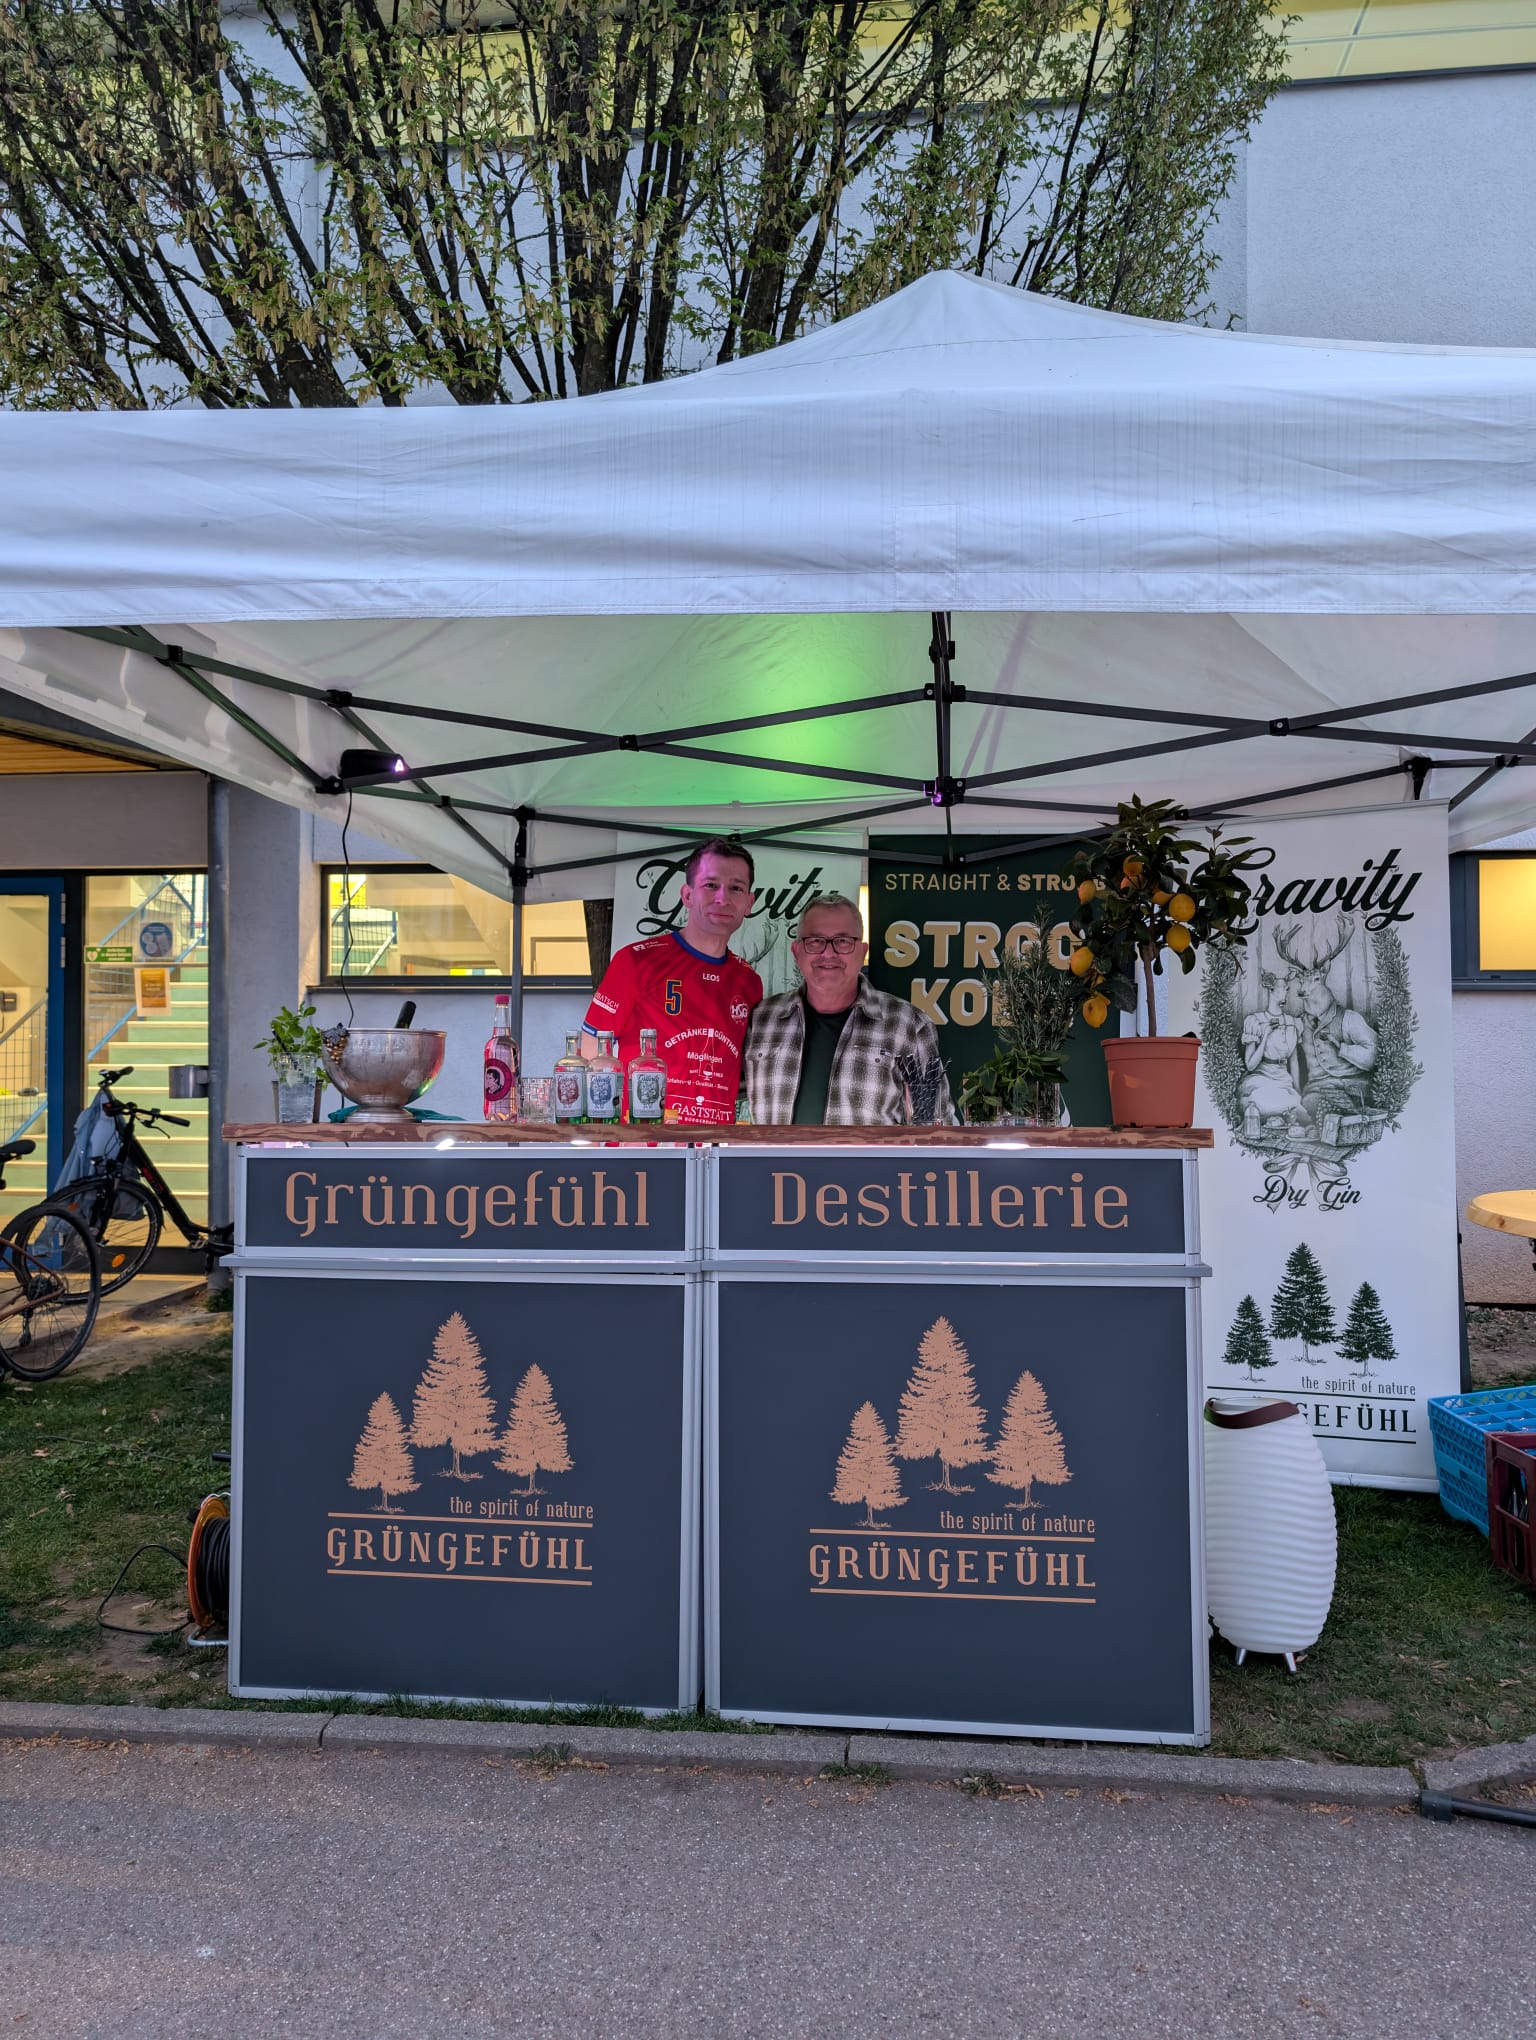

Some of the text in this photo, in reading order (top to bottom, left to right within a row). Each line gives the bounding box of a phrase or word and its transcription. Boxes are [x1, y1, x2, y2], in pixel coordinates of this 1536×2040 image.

[885, 873, 1106, 892] STRAIGHT & STROG
[636, 859, 839, 938] Gvit
[702, 972, 720, 982] LEOS
[665, 979, 682, 1016] 5
[664, 1027, 708, 1048] GETRÄNKE
[285, 1169, 1129, 1239] Grüngefühl Destillerie
[1252, 1174, 1361, 1212] Dry Gin
[1301, 1376, 1416, 1396] the spirit of nature
[449, 1496, 594, 1519] the spirit of nature
[940, 1510, 1096, 1534] the spirit of nature
[327, 1524, 593, 1572] GRÜNGEFÜHL
[809, 1541, 1097, 1590] GRÜNGEFÜHL
